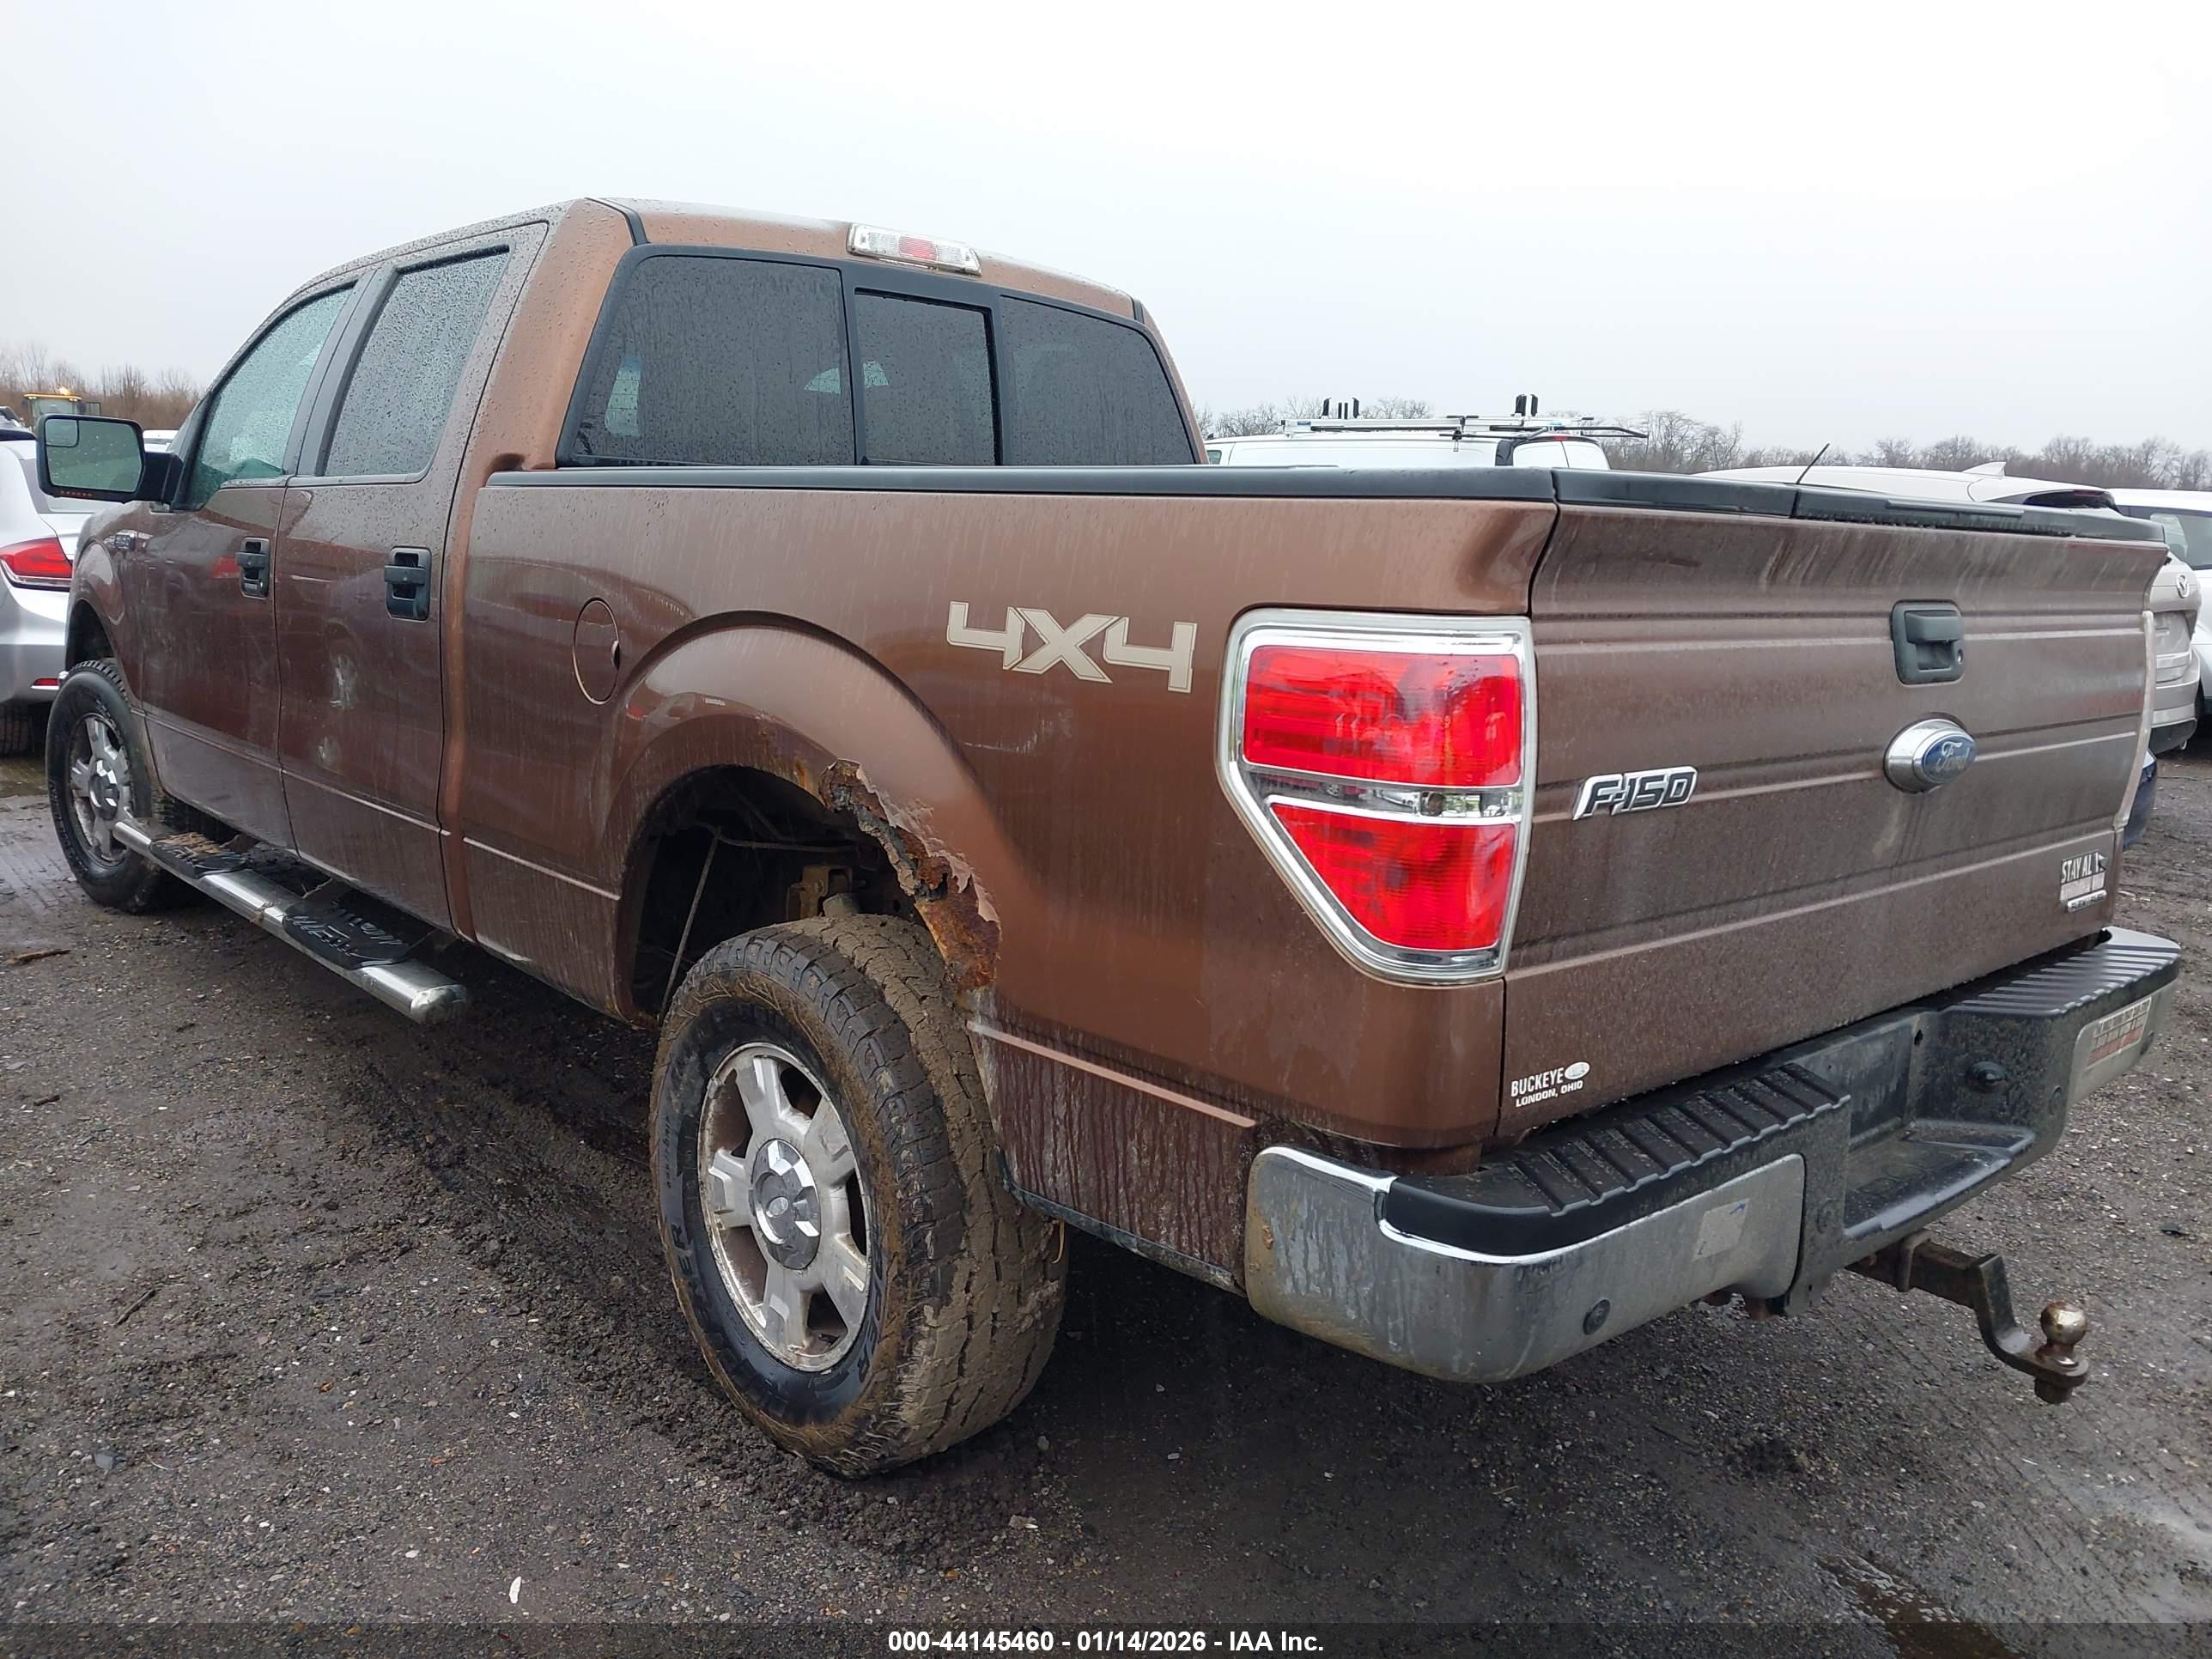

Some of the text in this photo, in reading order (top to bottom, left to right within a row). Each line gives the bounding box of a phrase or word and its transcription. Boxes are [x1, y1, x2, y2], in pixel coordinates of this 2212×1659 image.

[946, 600, 1198, 693] 4X4
[1937, 741, 1970, 772] Ford
[1573, 765, 1698, 820] F-150
[1510, 1067, 1565, 1097] BUCKEYE
[1516, 1080, 1583, 1108] LONDON, OHIO
